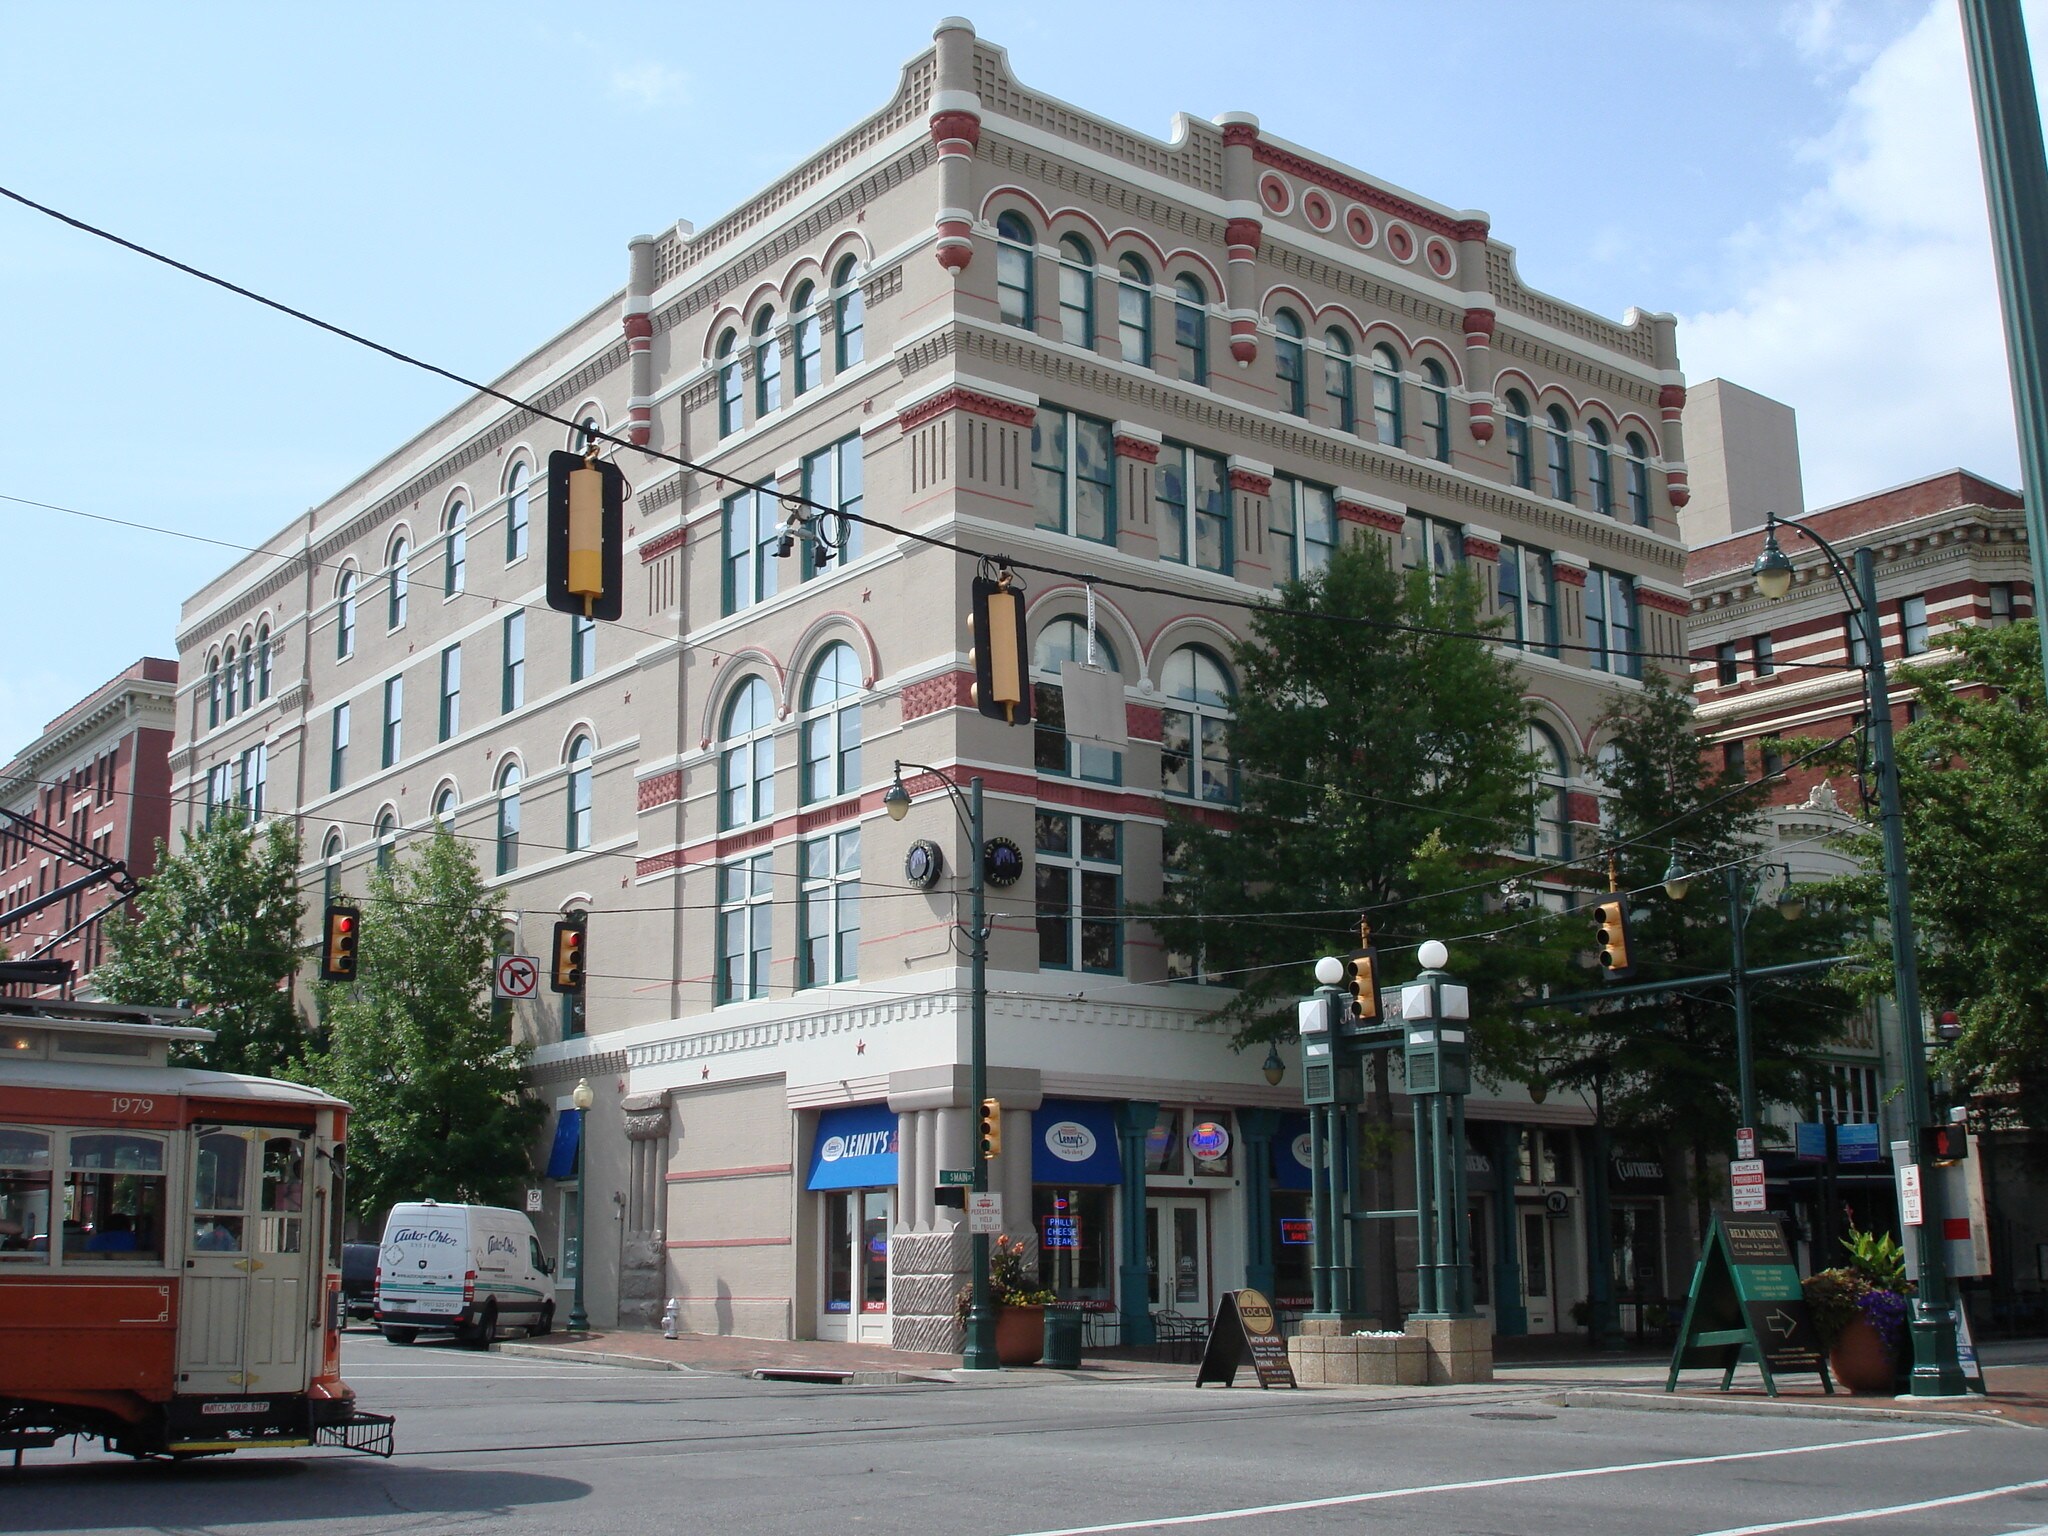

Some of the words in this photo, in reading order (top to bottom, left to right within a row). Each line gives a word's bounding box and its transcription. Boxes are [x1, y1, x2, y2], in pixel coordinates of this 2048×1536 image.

[111, 1097, 154, 1114] 1979
[841, 1130, 889, 1158] LENNY'S
[1058, 1130, 1083, 1149] Lenny's
[1734, 1164, 1760, 1172] VEHICLES
[954, 1172, 968, 1182] MAIN
[1734, 1175, 1762, 1184] PROHIBITED
[1746, 1187, 1762, 1195] MALL
[1050, 1218, 1074, 1227] PHILLY
[1047, 1228, 1077, 1236] CHEESE
[1747, 1229, 1778, 1239] MUSEUM
[394, 1228, 458, 1248] Auto-Chlor
[1047, 1238, 1078, 1246] STEAKS
[830, 1302, 850, 1310] CATERING
[1241, 1307, 1270, 1316] LOCAL
[203, 1404, 227, 1413] WATCH
[230, 1403, 248, 1412] YOUR
[250, 1402, 269, 1412] STEP
